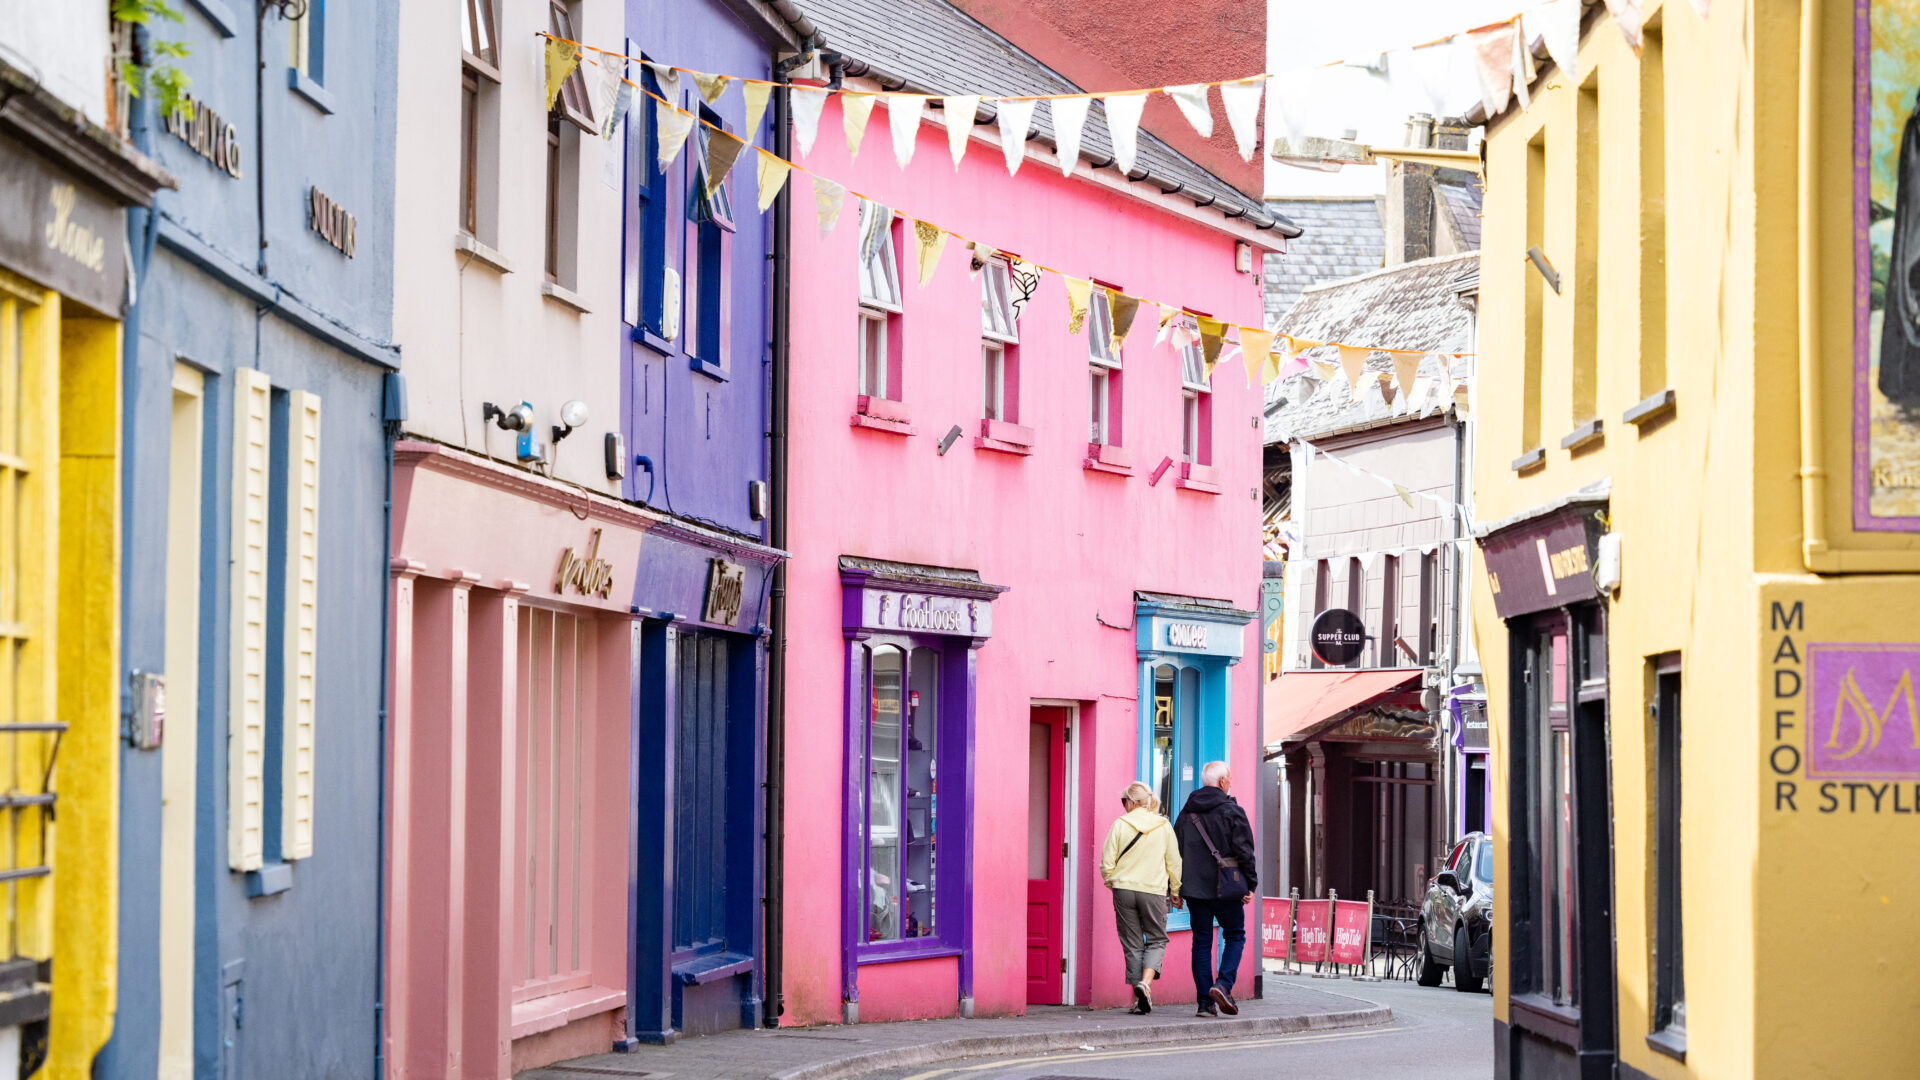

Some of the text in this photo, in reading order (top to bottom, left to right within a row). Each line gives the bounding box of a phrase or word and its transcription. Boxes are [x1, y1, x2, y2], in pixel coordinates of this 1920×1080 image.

[1769, 601, 1804, 811] MAD FOR
[1301, 927, 1314, 949] High
[1336, 927, 1349, 949] High
